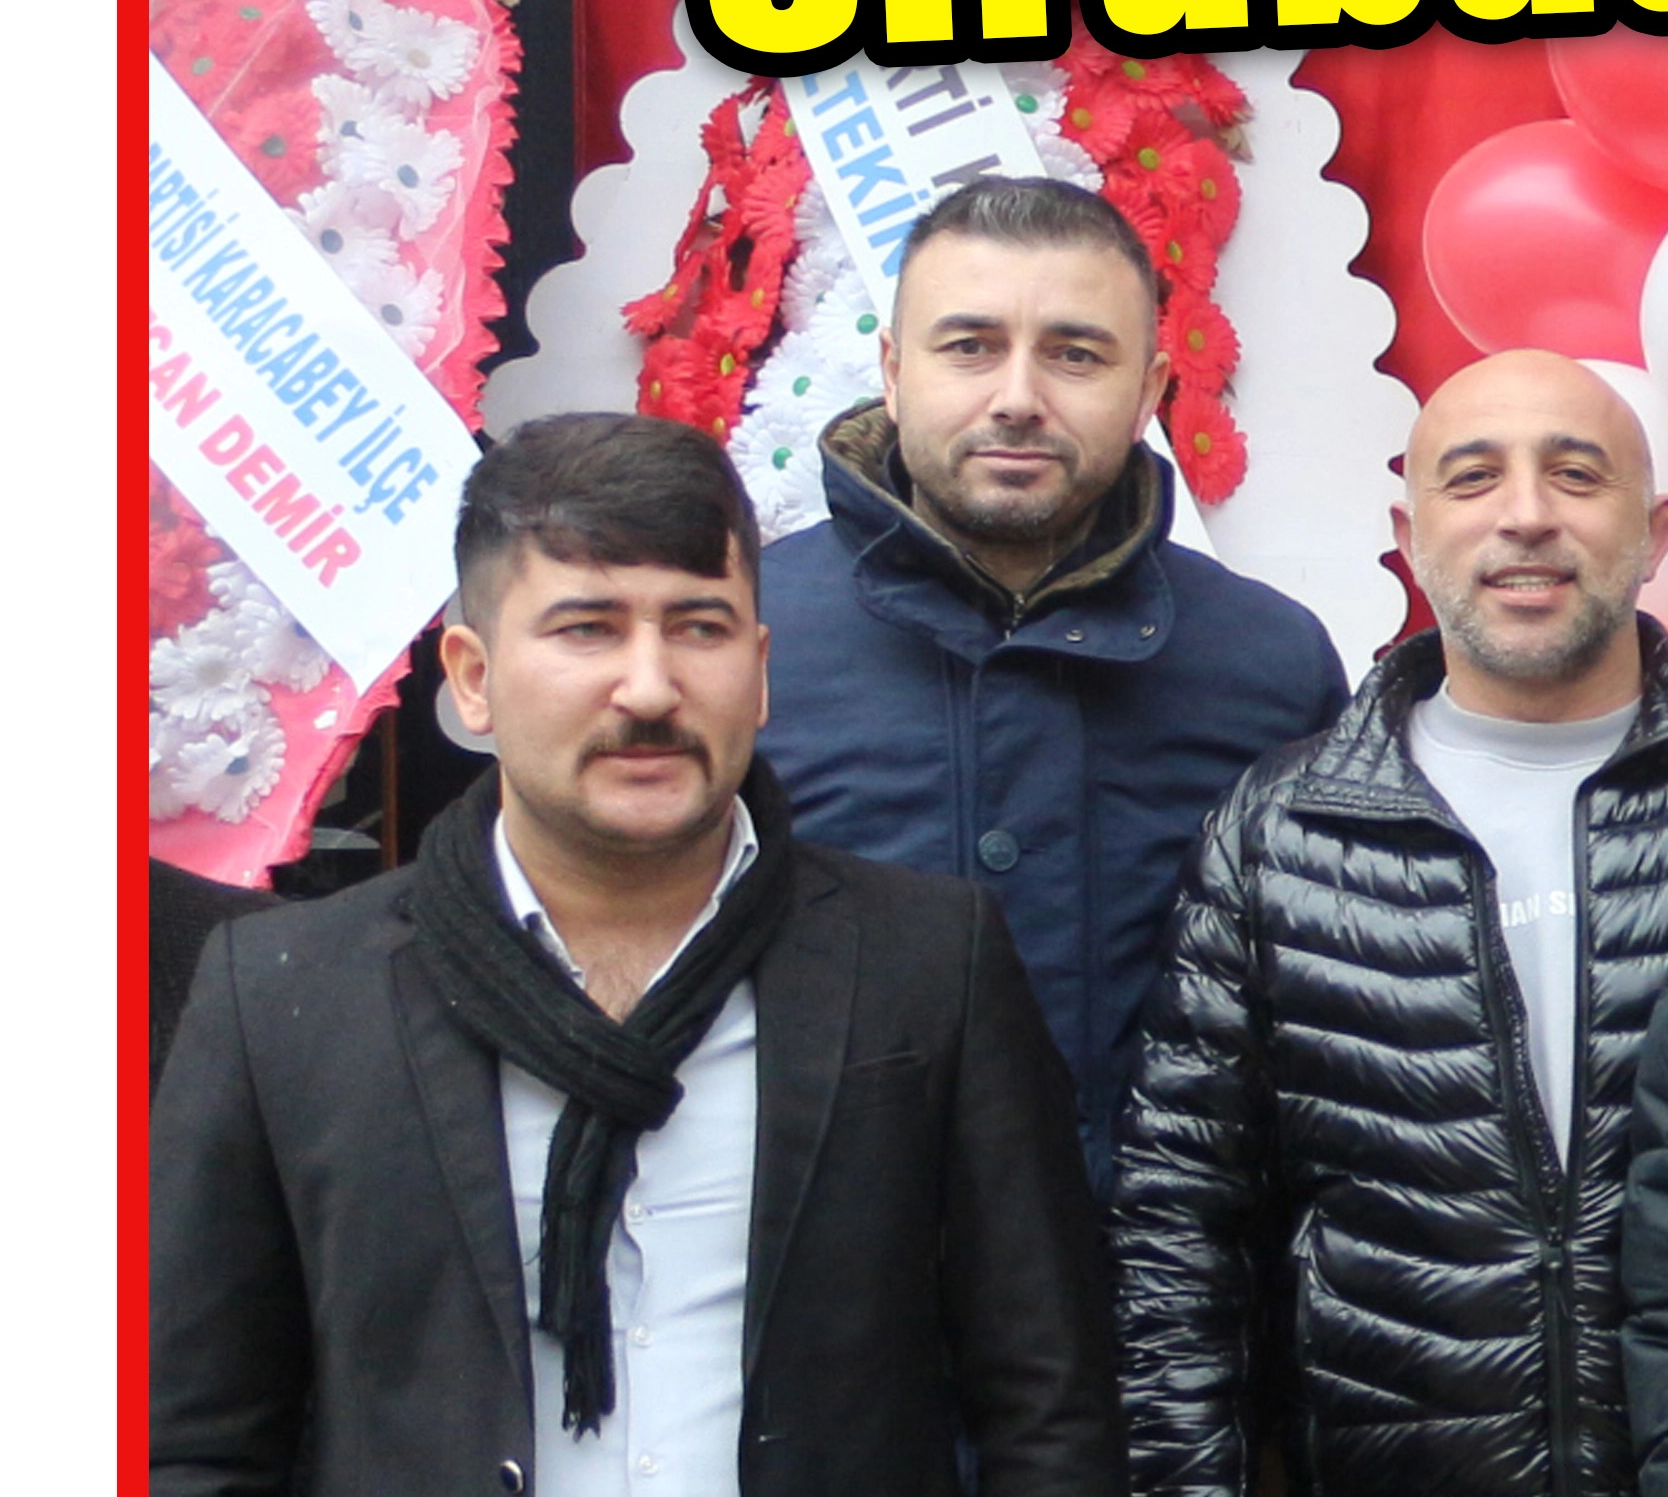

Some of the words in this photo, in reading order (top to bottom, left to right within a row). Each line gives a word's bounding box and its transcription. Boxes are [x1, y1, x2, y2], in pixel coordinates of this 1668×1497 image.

[183, 239, 379, 443] KARACABEY
[338, 403, 440, 525] İLÇE
[198, 413, 363, 589] DEMİR
